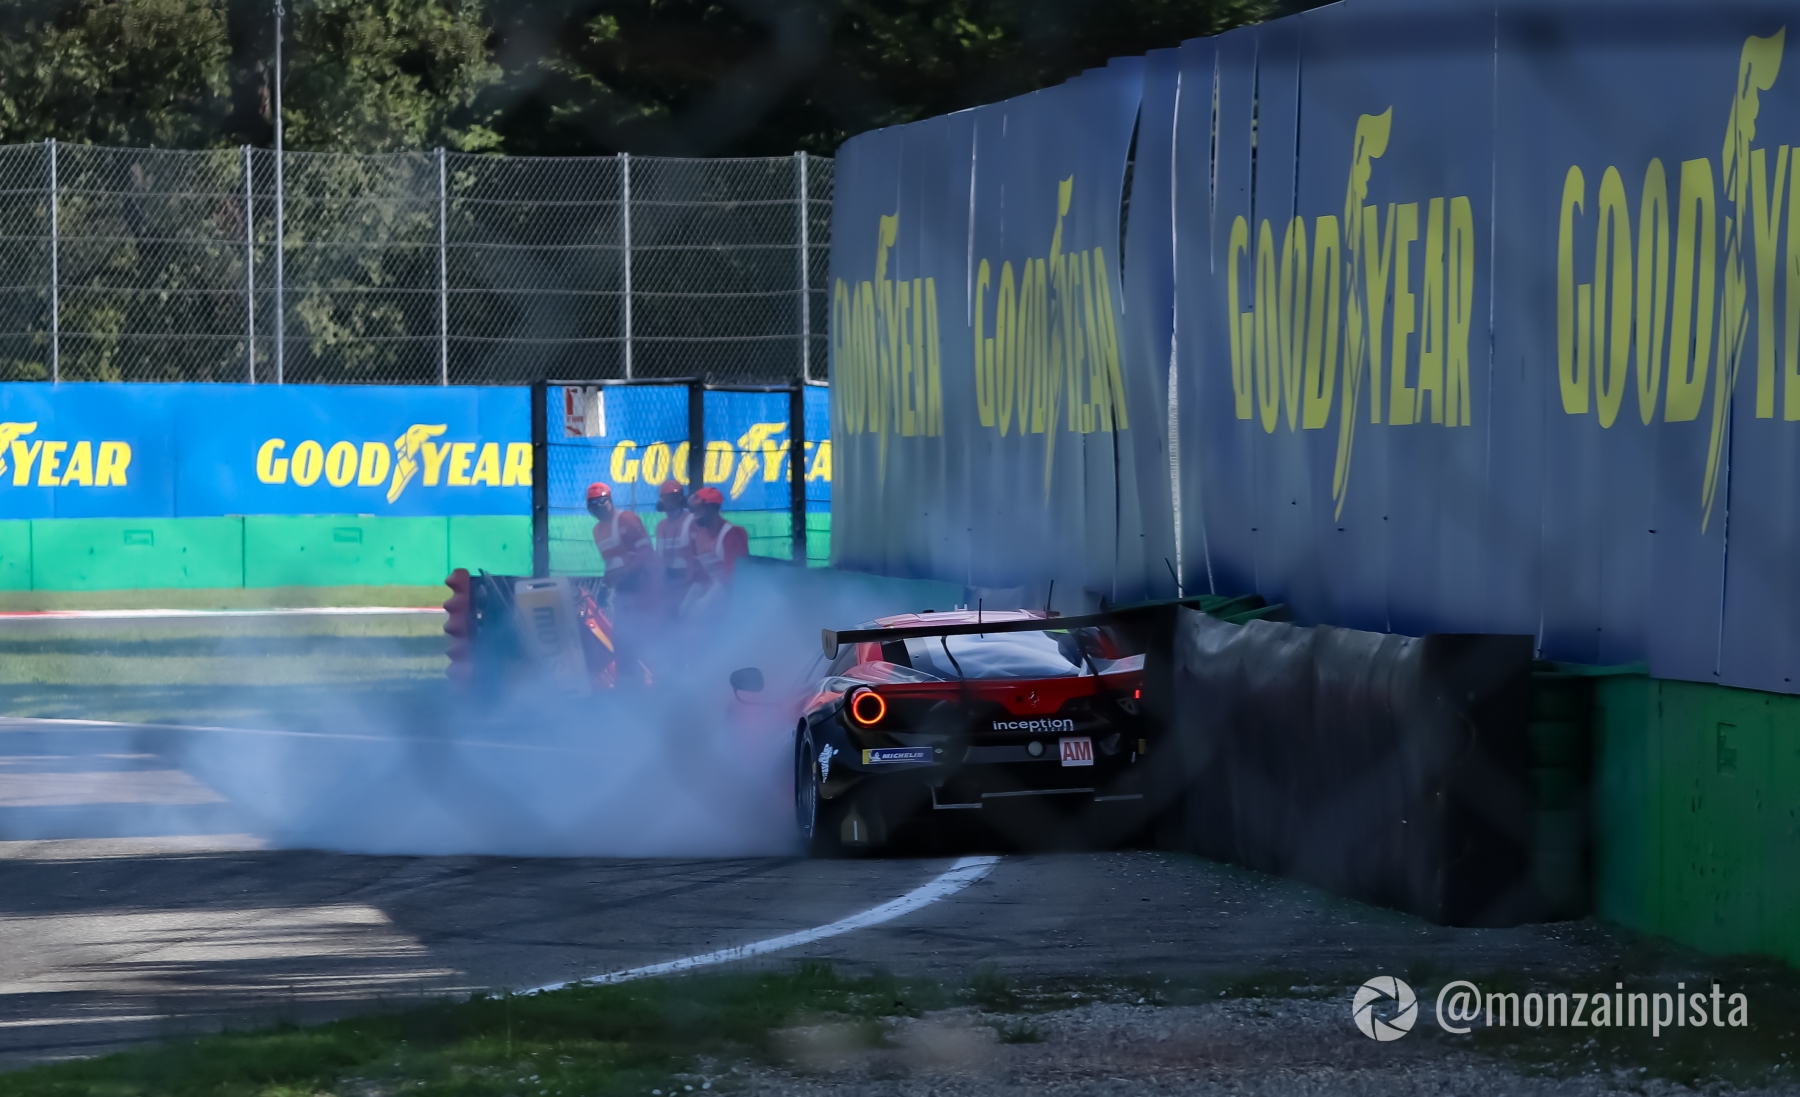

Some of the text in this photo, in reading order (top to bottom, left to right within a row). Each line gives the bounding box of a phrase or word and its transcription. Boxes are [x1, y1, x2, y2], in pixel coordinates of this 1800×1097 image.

[1228, 196, 1474, 434] GOODYEAR
[993, 718, 1074, 733] inception
[1062, 742, 1092, 762] AM
